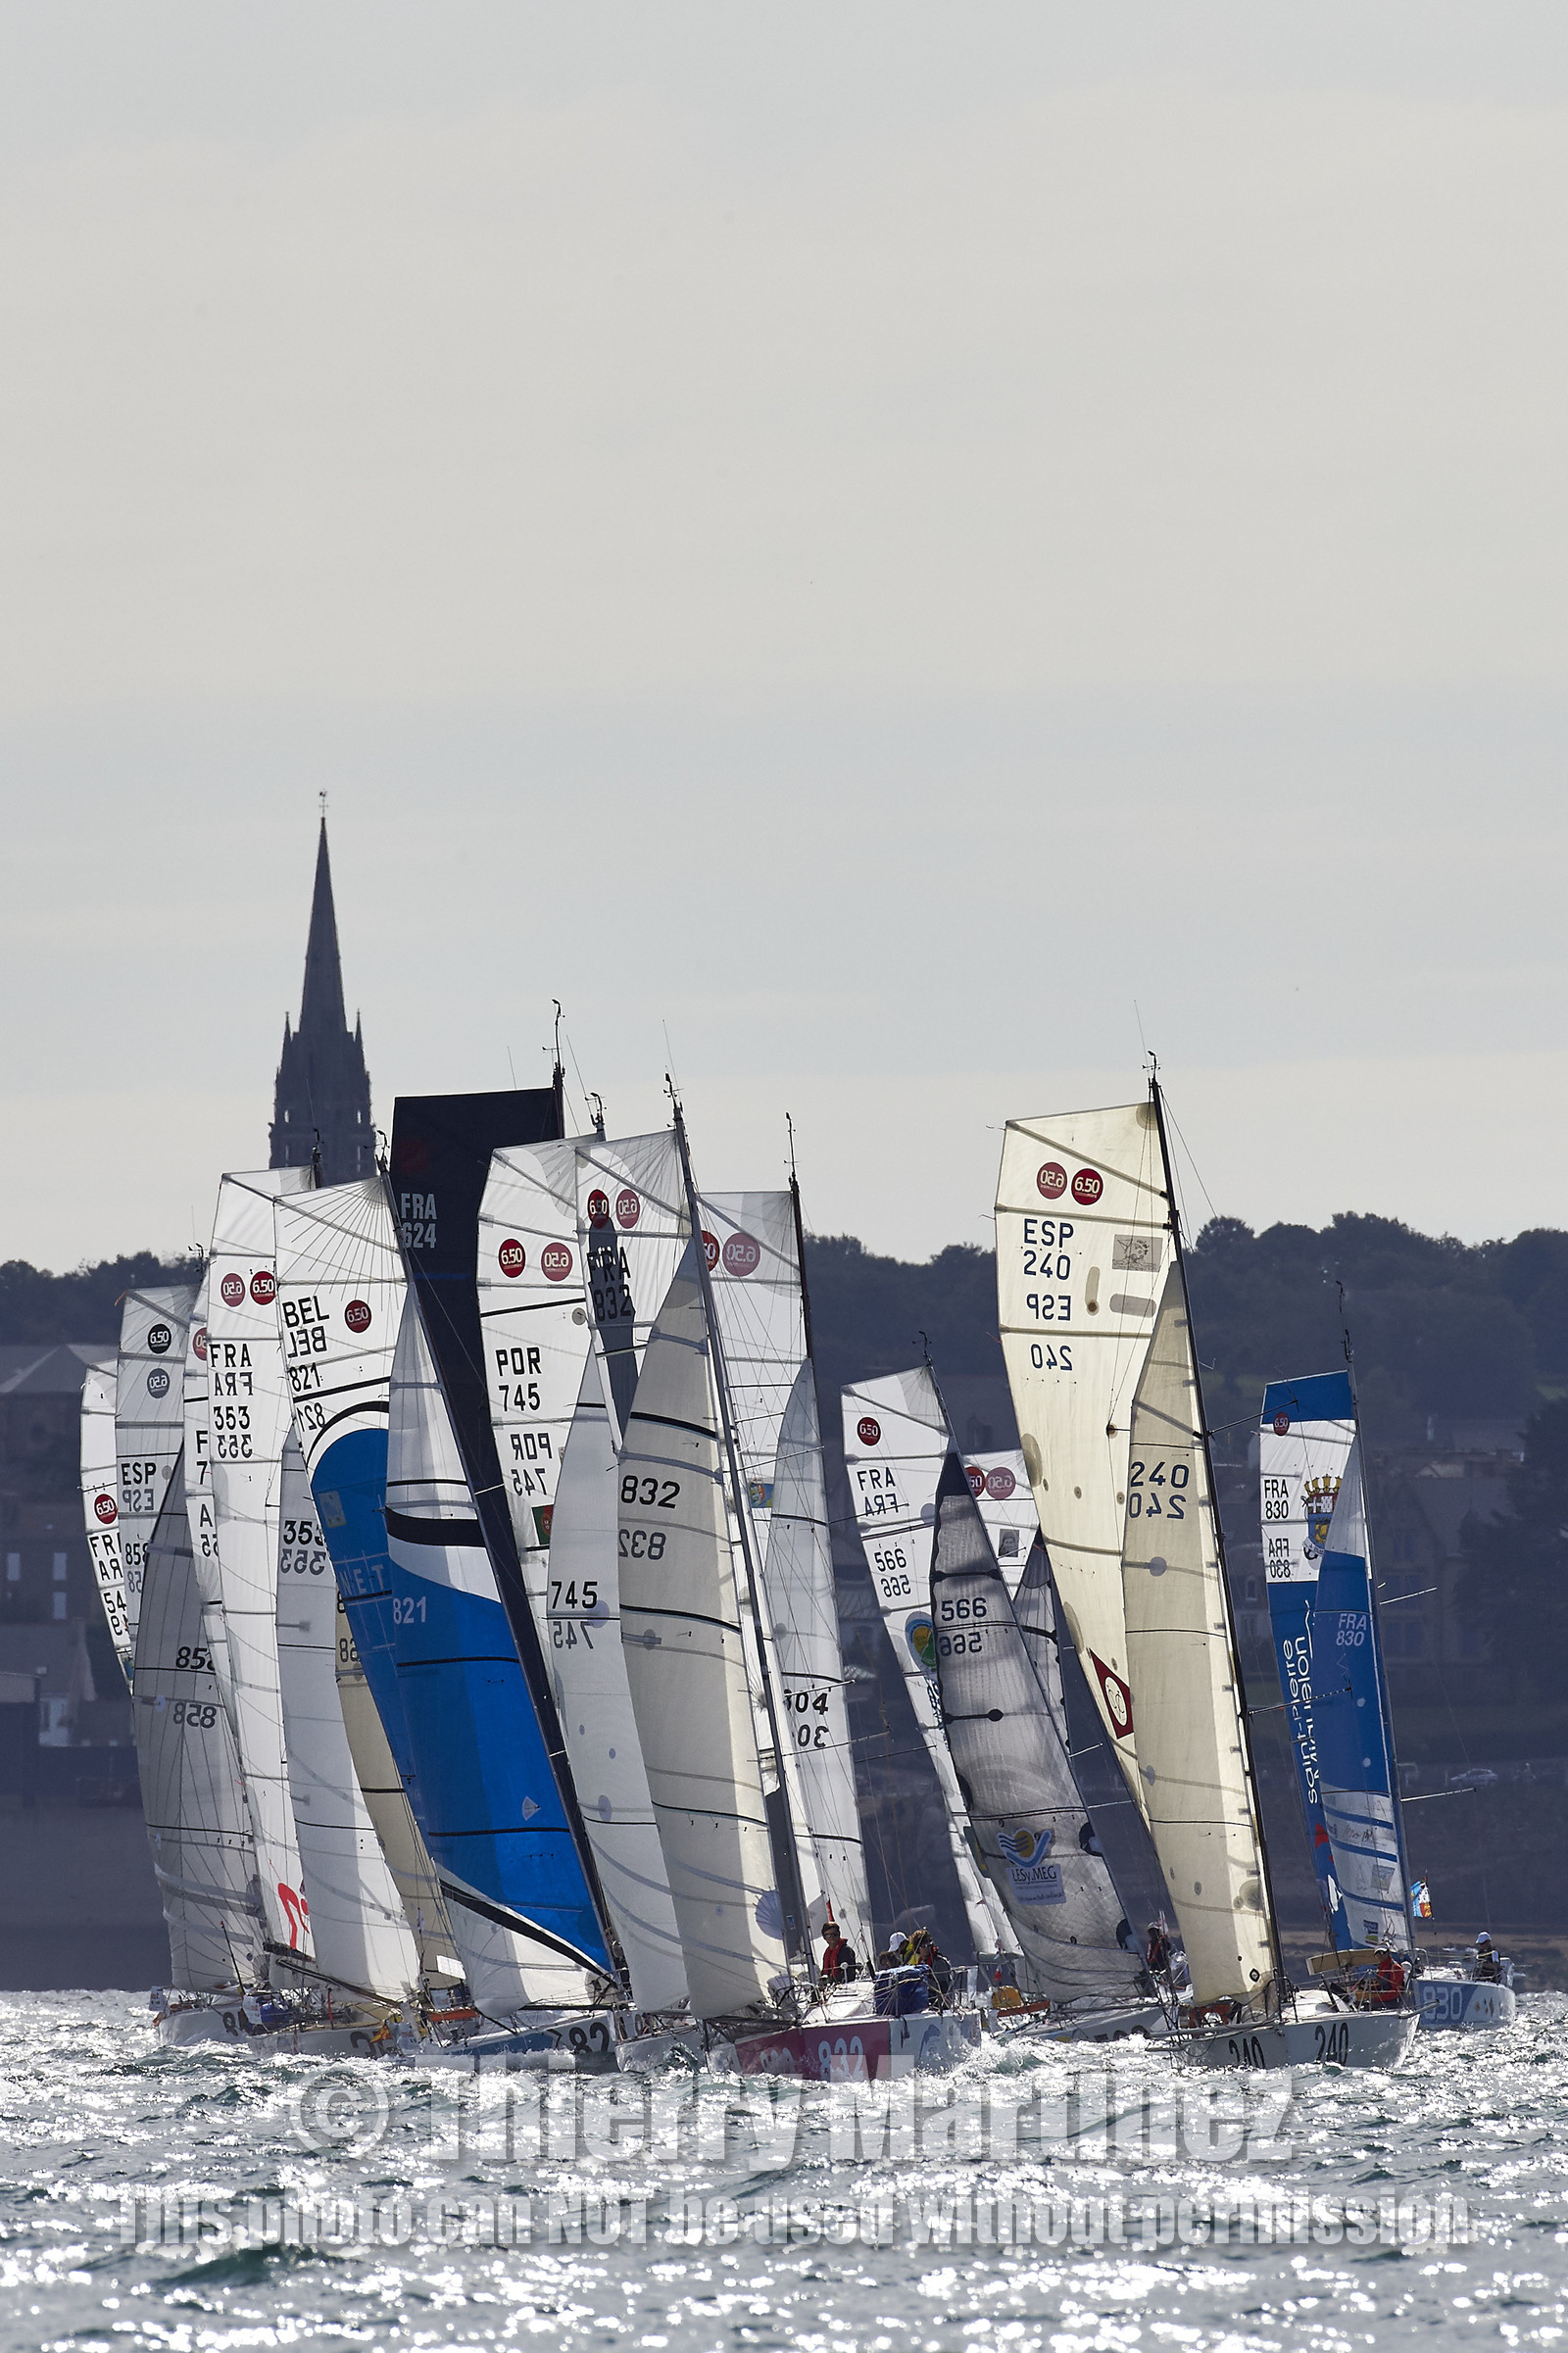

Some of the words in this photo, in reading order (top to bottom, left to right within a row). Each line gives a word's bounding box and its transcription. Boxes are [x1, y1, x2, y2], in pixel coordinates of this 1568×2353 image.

[1074, 1176, 1101, 1194] 6.50
[401, 1193, 437, 1219] FRA
[402, 1222, 436, 1249] 624
[1024, 1218, 1074, 1249] ESP
[501, 1248, 523, 1265] 6.50
[586, 1247, 631, 1284] FRA
[1023, 1250, 1071, 1281] 240
[252, 1279, 274, 1294] 6.50
[282, 1296, 330, 1328] BEL
[347, 1305, 369, 1323] 6.50
[593, 1284, 632, 1322] 832
[149, 1330, 171, 1345] 6.50
[209, 1344, 252, 1368] FRA
[495, 1347, 542, 1377] POR
[288, 1362, 321, 1392] 821
[498, 1383, 540, 1412] 745
[213, 1405, 251, 1430] 353
[121, 1462, 157, 1485] ESP
[857, 1467, 897, 1492] FRA
[1129, 1461, 1190, 1489] 240
[620, 1475, 681, 1509] 832
[1264, 1479, 1289, 1498] FRA
[96, 1499, 116, 1515] 6.50
[1265, 1499, 1290, 1520] 830
[89, 1532, 122, 1558] FR
[874, 1547, 906, 1573] 566
[551, 1581, 599, 1609] 745
[393, 1596, 427, 1625] 821
[941, 1597, 988, 1622] 566
[1339, 1612, 1367, 1632] FRA
[1336, 1631, 1365, 1647] 830
[1283, 1639, 1318, 1804] saint-pierre
[1423, 1985, 1464, 2021] 830
[1314, 2022, 1349, 2067] 240
[817, 2035, 864, 2082] 832
